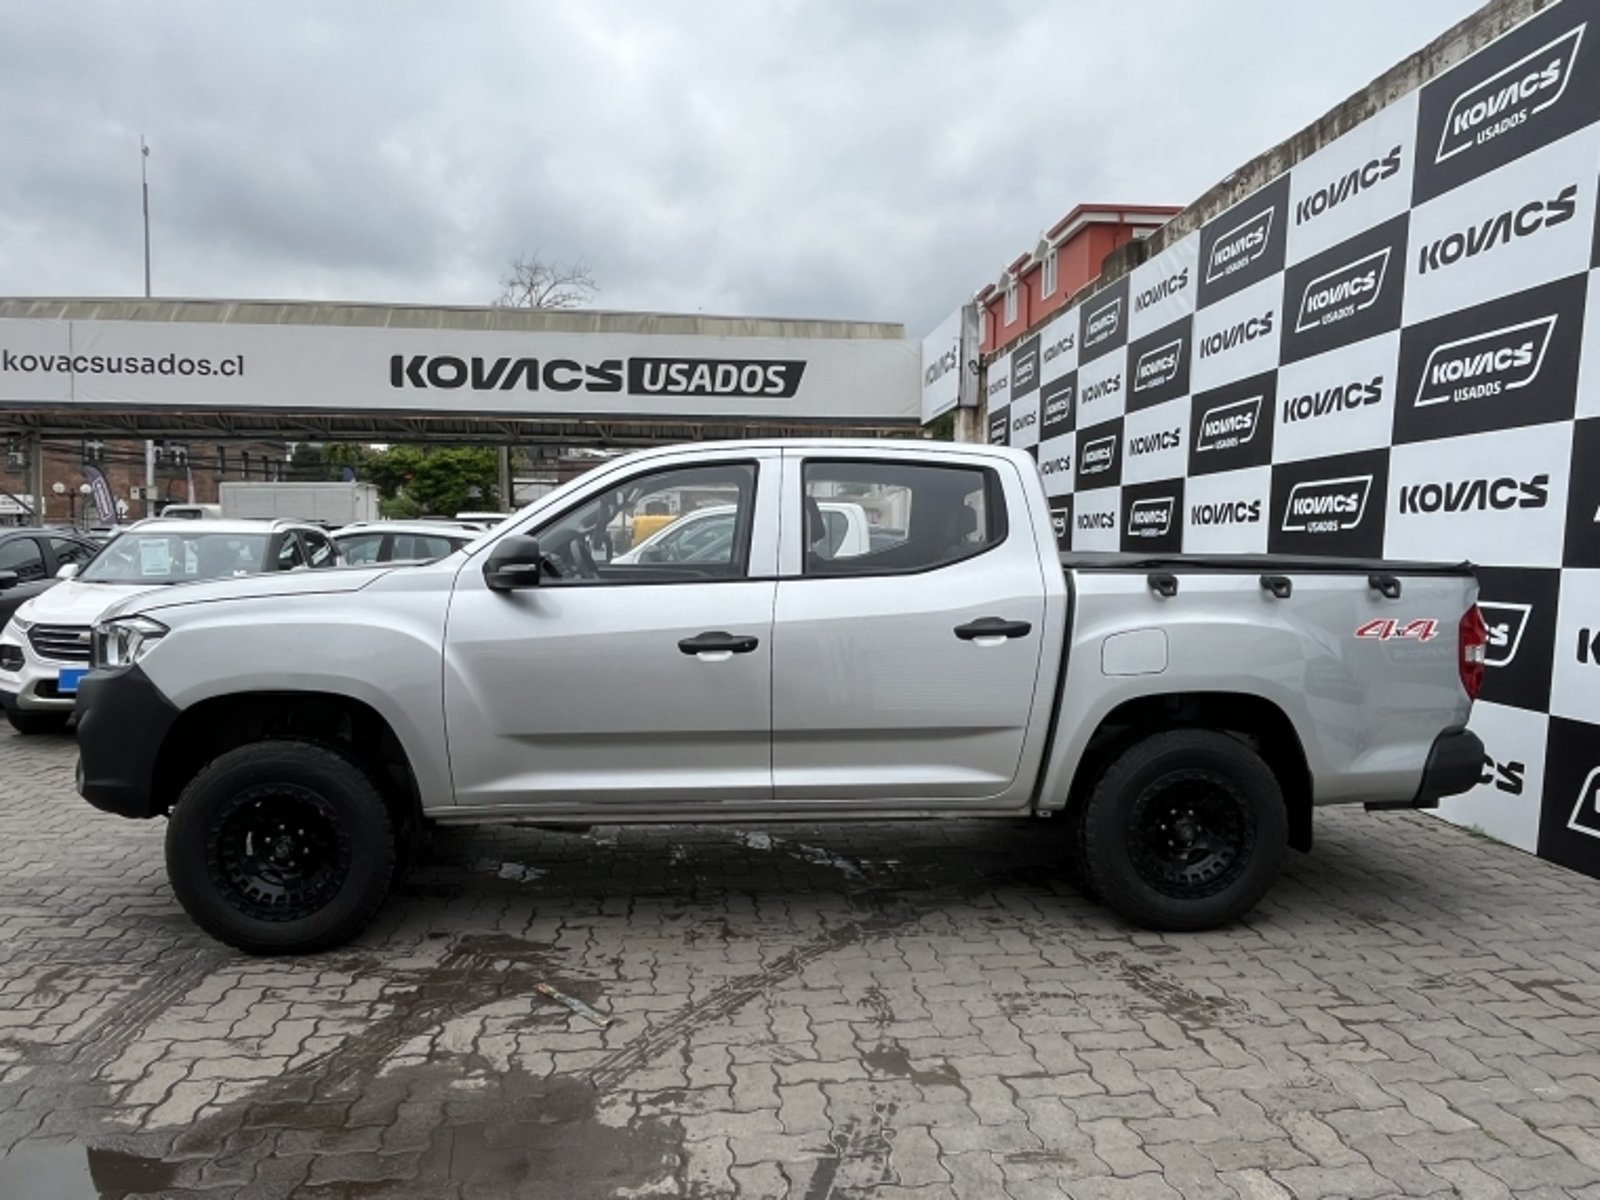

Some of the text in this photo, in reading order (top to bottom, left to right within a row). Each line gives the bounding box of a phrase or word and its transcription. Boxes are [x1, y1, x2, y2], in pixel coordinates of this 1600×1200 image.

[1453, 58, 1560, 136] KOVACS
[1477, 109, 1527, 145] USADOS
[1296, 145, 1402, 226] KOVACS
[1214, 226, 1264, 266] KOVACS
[1418, 184, 1577, 274] KOVACS
[1135, 266, 1188, 312] KOVACS
[1307, 270, 1376, 313] KOVACS
[1321, 305, 1355, 325] USADOS
[1200, 310, 1273, 358] KOVACS
[2, 350, 244, 377] kovacsusados.cl
[390, 354, 787, 395] KOVACS USADOS
[1431, 342, 1533, 385] KOVACS
[1081, 374, 1120, 404] KOVACS
[1283, 376, 1383, 424] KOVACS
[1454, 381, 1501, 402] USADOS
[1128, 427, 1181, 457] KOVACS
[1205, 412, 1253, 437] KOVACS
[1293, 493, 1358, 515] KOVACS
[1399, 474, 1550, 514] KOVACS
[1077, 511, 1115, 529] KOVACS
[1134, 509, 1168, 524] KOVACS
[1191, 500, 1261, 525] KOVACS
[1307, 520, 1339, 532] USADOS
